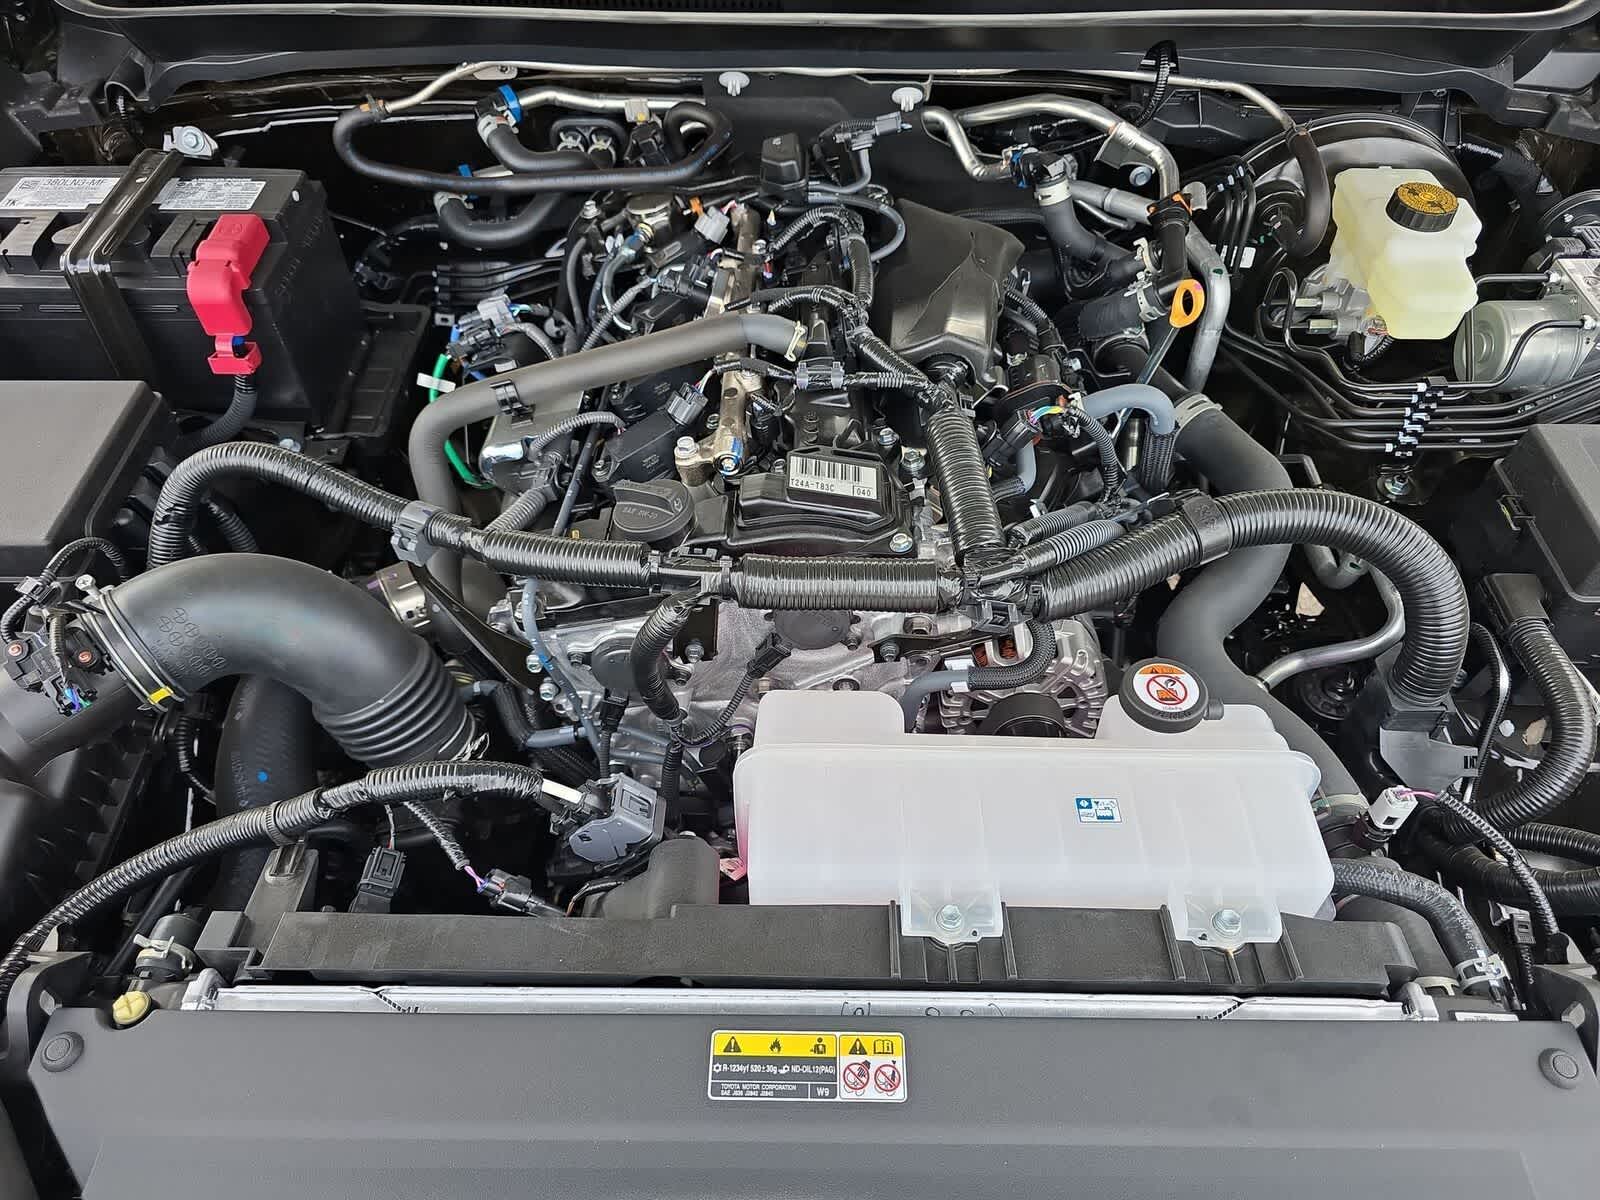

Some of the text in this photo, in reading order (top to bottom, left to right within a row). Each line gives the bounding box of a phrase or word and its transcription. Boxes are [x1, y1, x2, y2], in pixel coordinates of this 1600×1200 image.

[856, 487, 872, 497] 040
[722, 1063, 749, 1074] R-1234yf
[750, 1064, 777, 1074] 520±30g
[816, 1087, 830, 1097] W9
